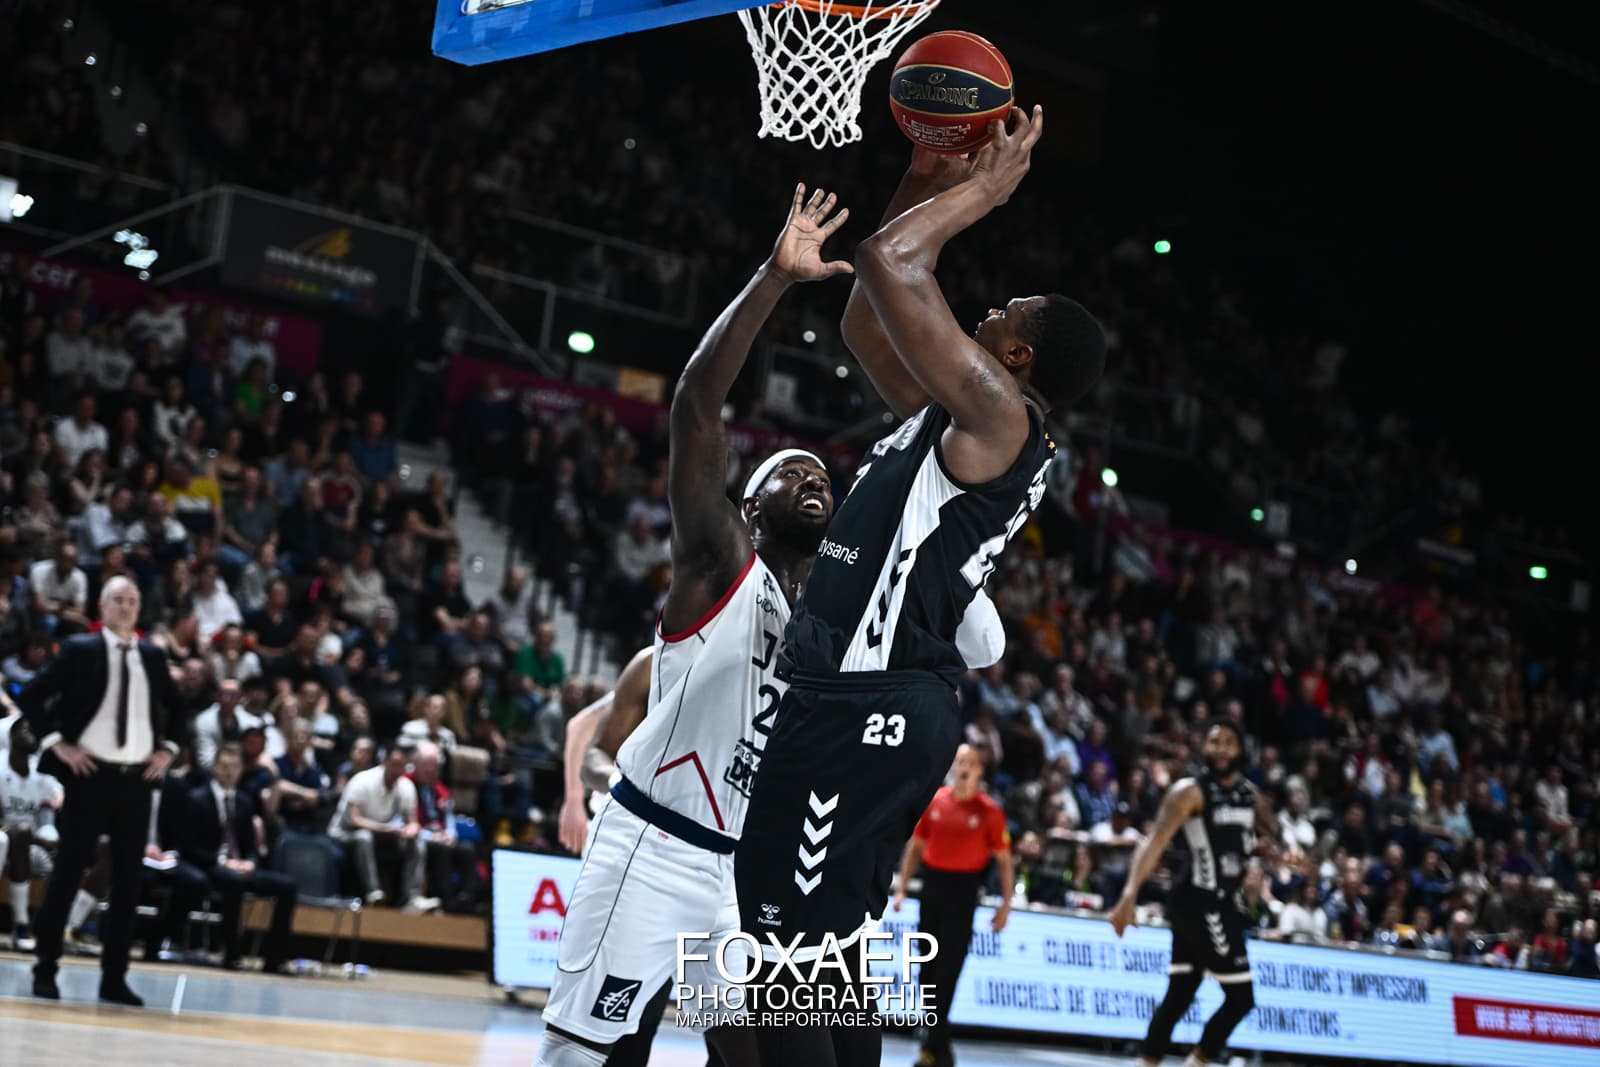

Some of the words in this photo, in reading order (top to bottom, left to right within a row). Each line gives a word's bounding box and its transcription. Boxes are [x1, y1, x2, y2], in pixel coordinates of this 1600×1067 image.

[901, 79, 979, 109] SPALDING
[902, 114, 971, 137] LEGACY
[862, 712, 906, 747] 23
[1256, 961, 1332, 993] SOLUTIONS
[974, 977, 1061, 1012] LOGICIELS
[1067, 986, 1087, 1015] DE
[1255, 1005, 1340, 1039] ORMATIONS
